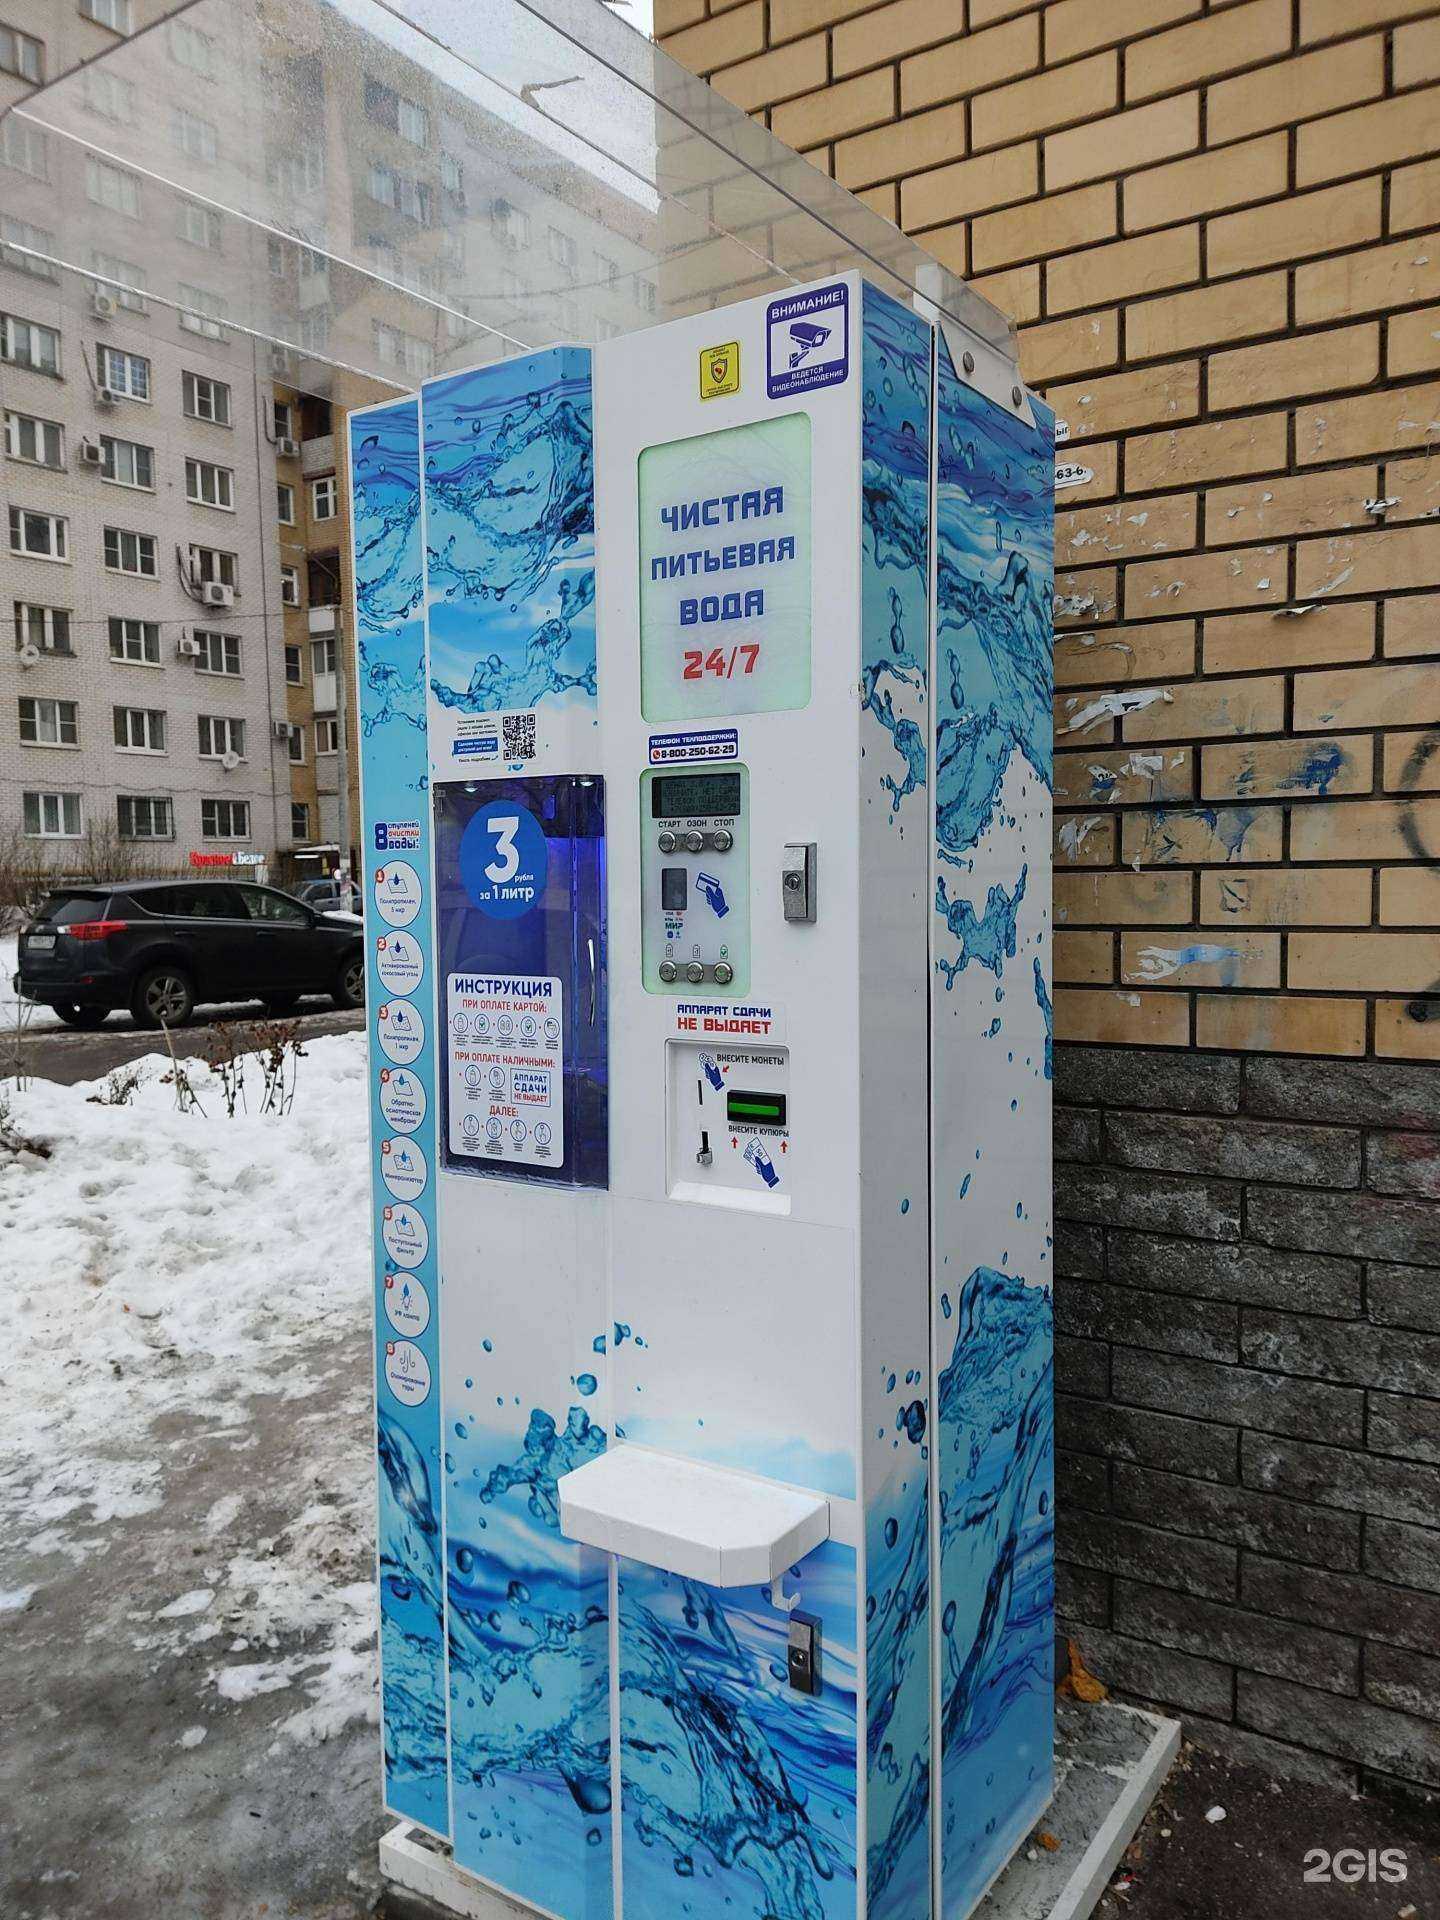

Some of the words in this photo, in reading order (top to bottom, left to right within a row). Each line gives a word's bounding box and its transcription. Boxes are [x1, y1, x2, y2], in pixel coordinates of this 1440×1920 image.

[771, 290, 844, 319] ВНИМАНИЕ!
[791, 366, 824, 380] ВЕДЕТСЯ
[772, 369, 844, 392] ВИДЕОНАБЛЮДЕНИЕ
[661, 486, 784, 532] ЧИСТАЯ
[651, 535, 795, 580] ПИТЬЕВАЯ
[680, 589, 764, 626] ВОДА
[683, 644, 760, 680] 24/7
[651, 737, 681, 746] ТЕЛЕФОН
[661, 744, 735, 759] 8-800-250-62-29
[388, 820, 419, 830] ступеней
[658, 820, 681, 828] СТАРТ
[687, 819, 707, 827] ОЗОН
[714, 818, 735, 826] СТОП
[375, 822, 388, 850] 8
[389, 837, 419, 849] воды:
[484, 816, 520, 884] 3
[514, 873, 534, 883] рубля
[480, 892, 491, 900] за
[492, 885, 499, 900] 1
[501, 886, 535, 902] литр
[665, 922, 684, 930] МИР
[455, 979, 552, 998] ИНСТРУКЦИЯ
[462, 999, 478, 1008] ПРИ
[480, 1000, 511, 1011] ОПЛАТЕ
[513, 1000, 547, 1013] КАРТОЙ:
[677, 1004, 729, 1016] АППАРАТ
[733, 1006, 771, 1018] СДАЧИ
[677, 1017, 698, 1031] НЕ
[703, 1018, 771, 1034] ВЫДАЕТ
[455, 1051, 470, 1061] ПРИ
[472, 1053, 501, 1063] ОПЛАТЕ
[503, 1055, 556, 1068] НАЛИЧНЫМИ:
[716, 1053, 750, 1064] ВНЕСИТЕ
[751, 1056, 785, 1066] МОНЕТЫ
[514, 1073, 547, 1083] АППАРАТ
[514, 1083, 547, 1094] СДАЧИ
[514, 1093, 522, 1101] НЕ
[523, 1094, 548, 1103] ВЫДАЕТ
[489, 1105, 519, 1118] ДАЛЕЕ:
[728, 1124, 758, 1135] ВНЕСИТЕ
[760, 1127, 789, 1138] КУПЮРЫ
